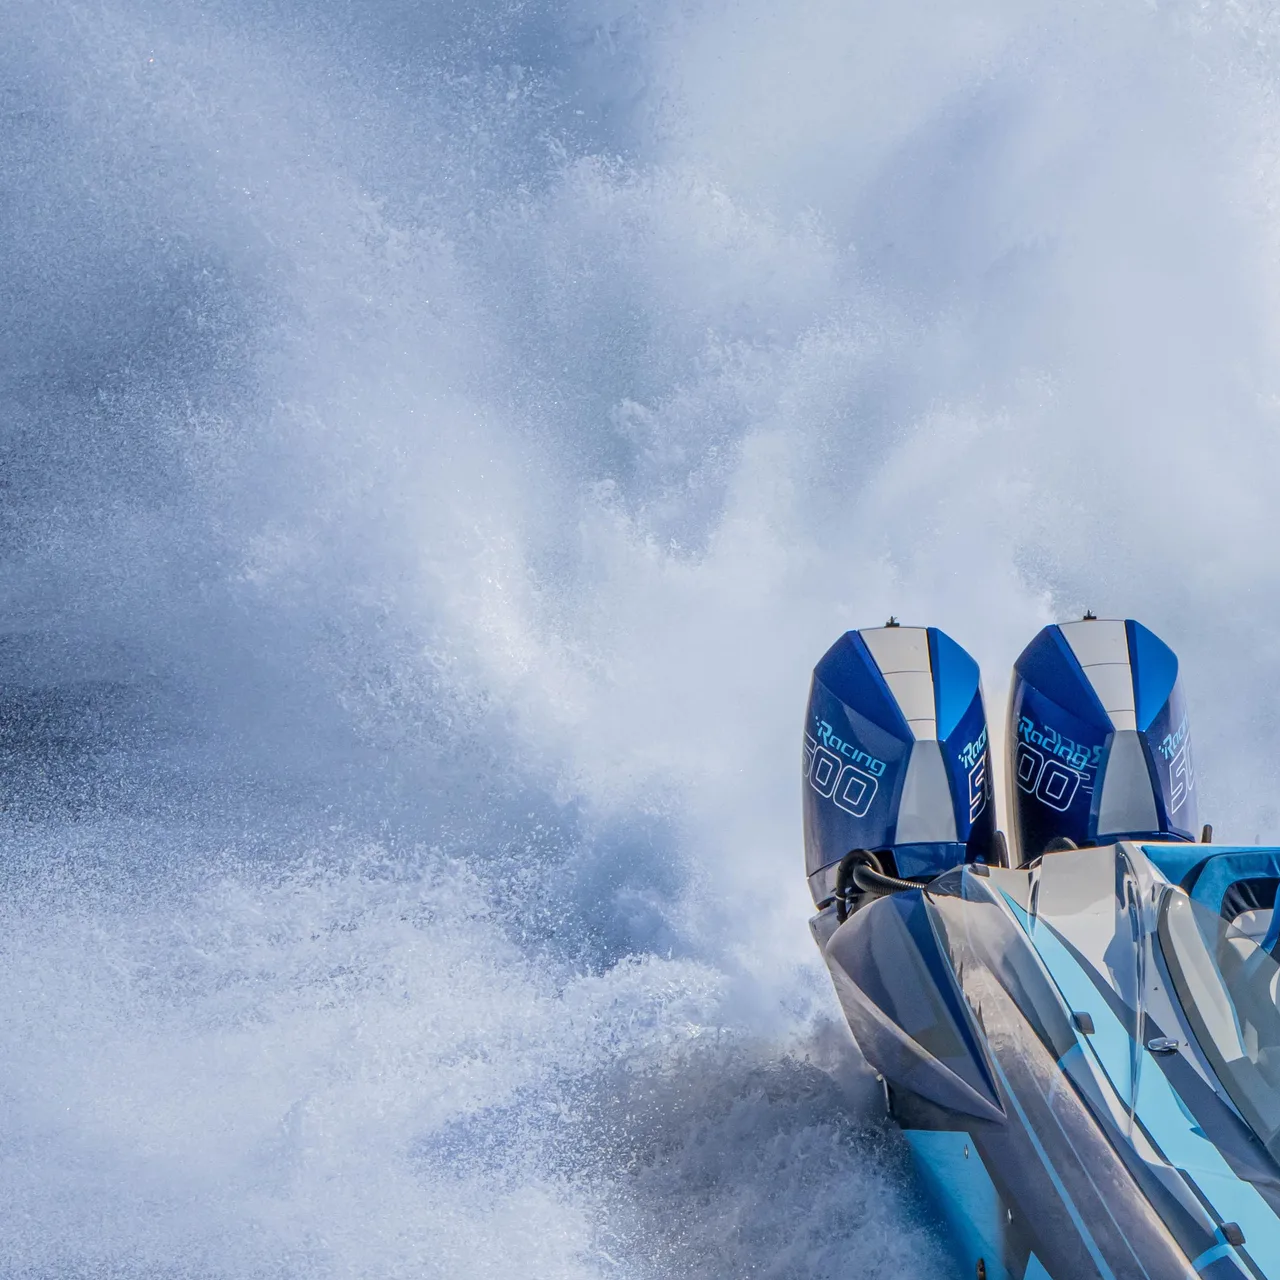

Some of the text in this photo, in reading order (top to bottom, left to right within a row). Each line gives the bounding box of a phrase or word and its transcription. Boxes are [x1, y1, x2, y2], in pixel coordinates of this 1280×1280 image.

[817, 720, 887, 777] Racing
[1019, 716, 1088, 771] Racing
[1014, 735, 1081, 812] 00
